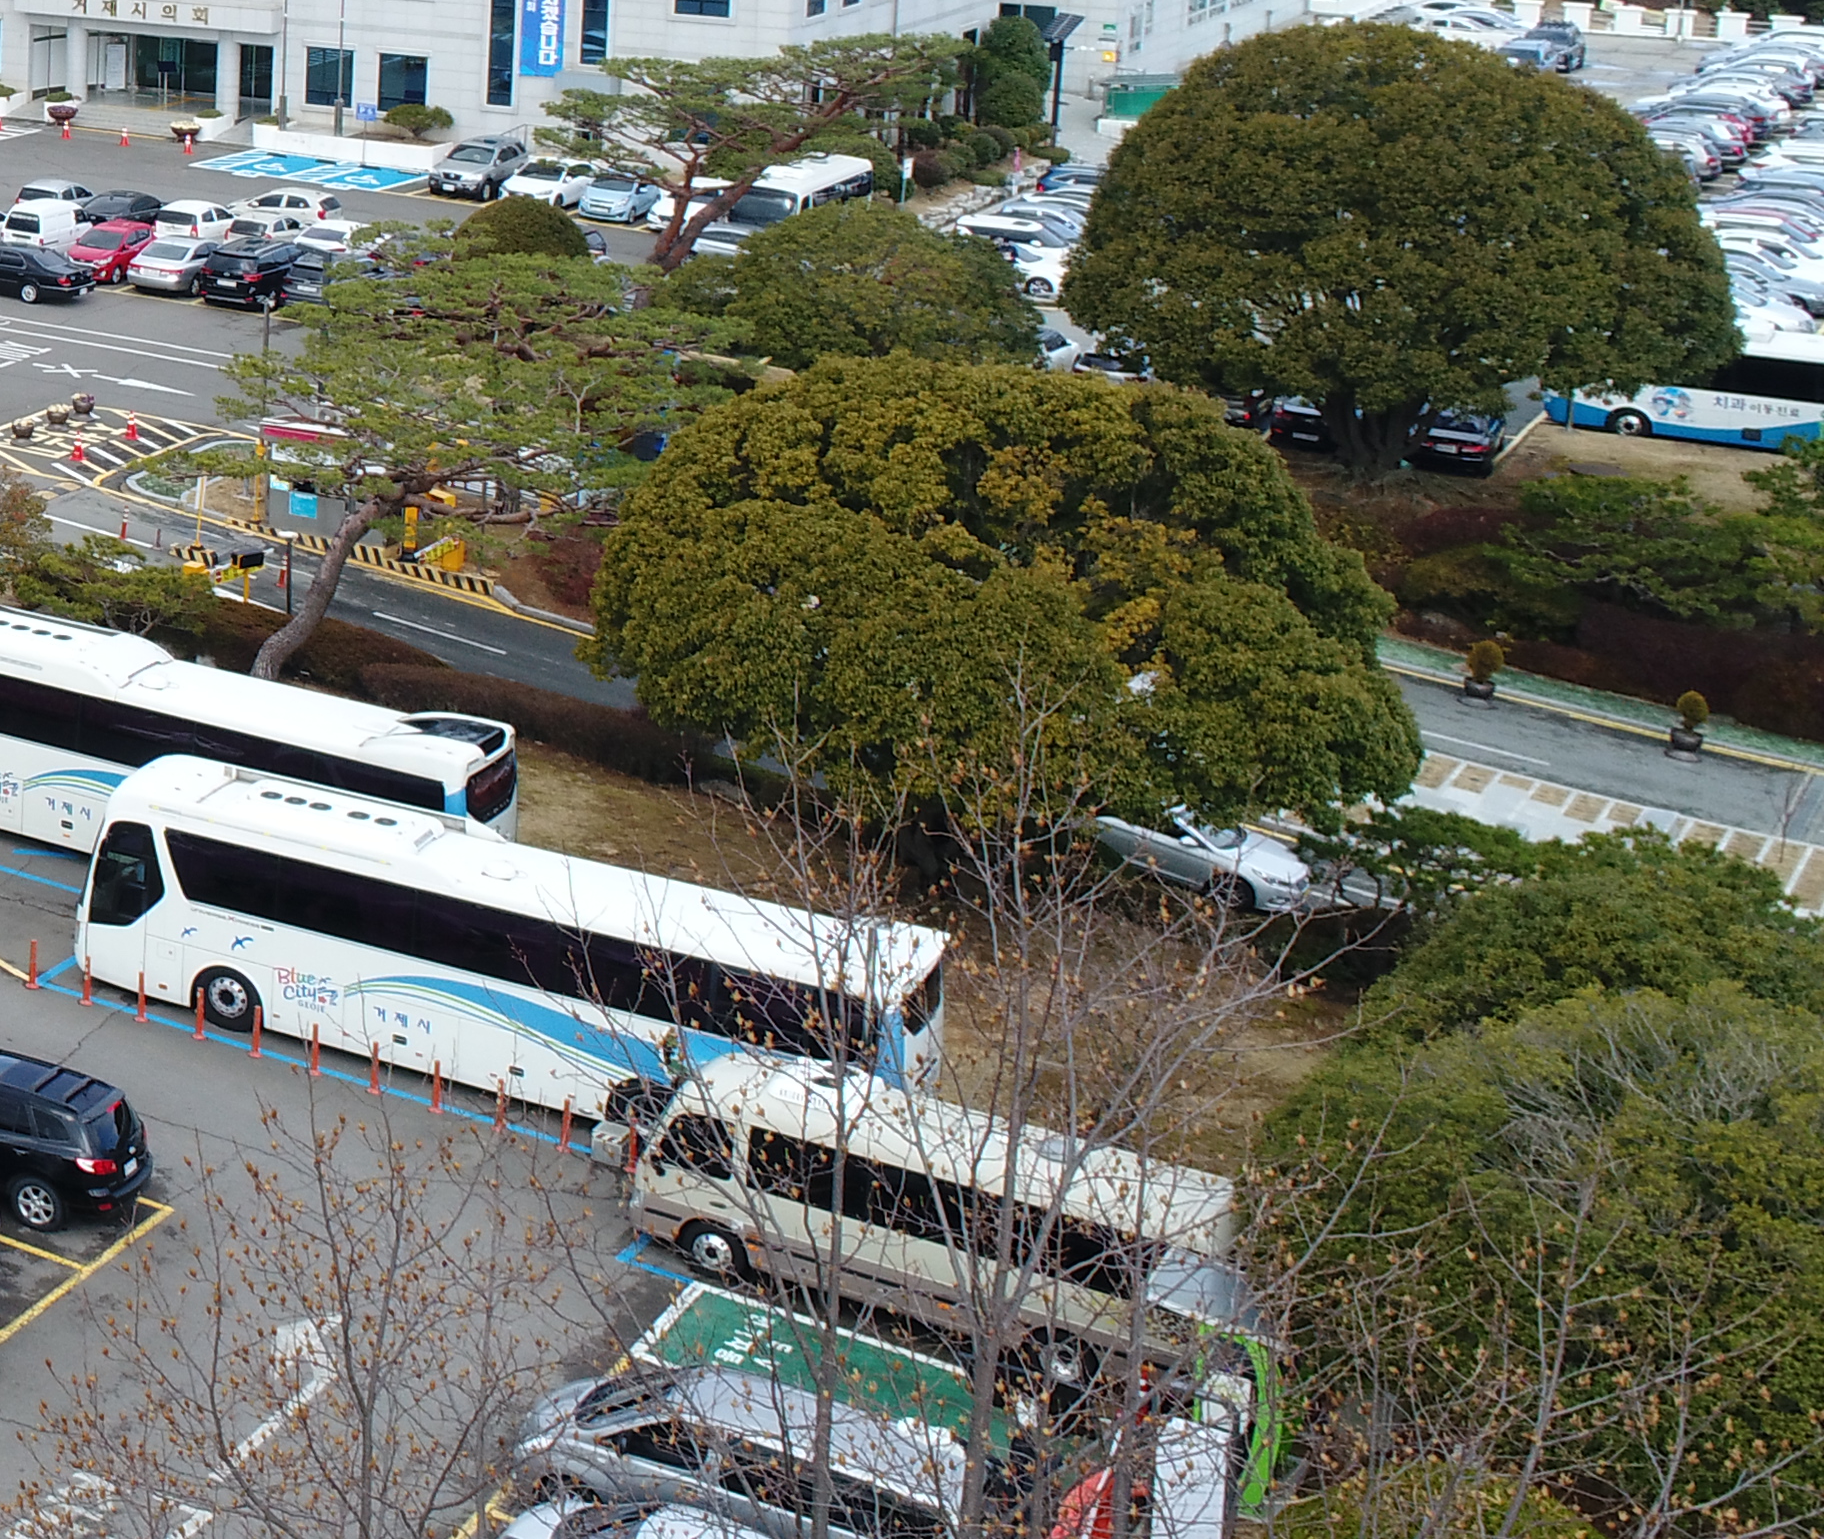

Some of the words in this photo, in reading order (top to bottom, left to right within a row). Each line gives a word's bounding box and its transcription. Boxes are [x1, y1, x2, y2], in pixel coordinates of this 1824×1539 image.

[1713, 395, 1746, 411] 치과
[45, 796, 91, 821] 거제시
[273, 967, 316, 985] Blue
[283, 985, 318, 1001] City
[298, 999, 325, 1014] GEOJE
[373, 1006, 431, 1034] 거제시
